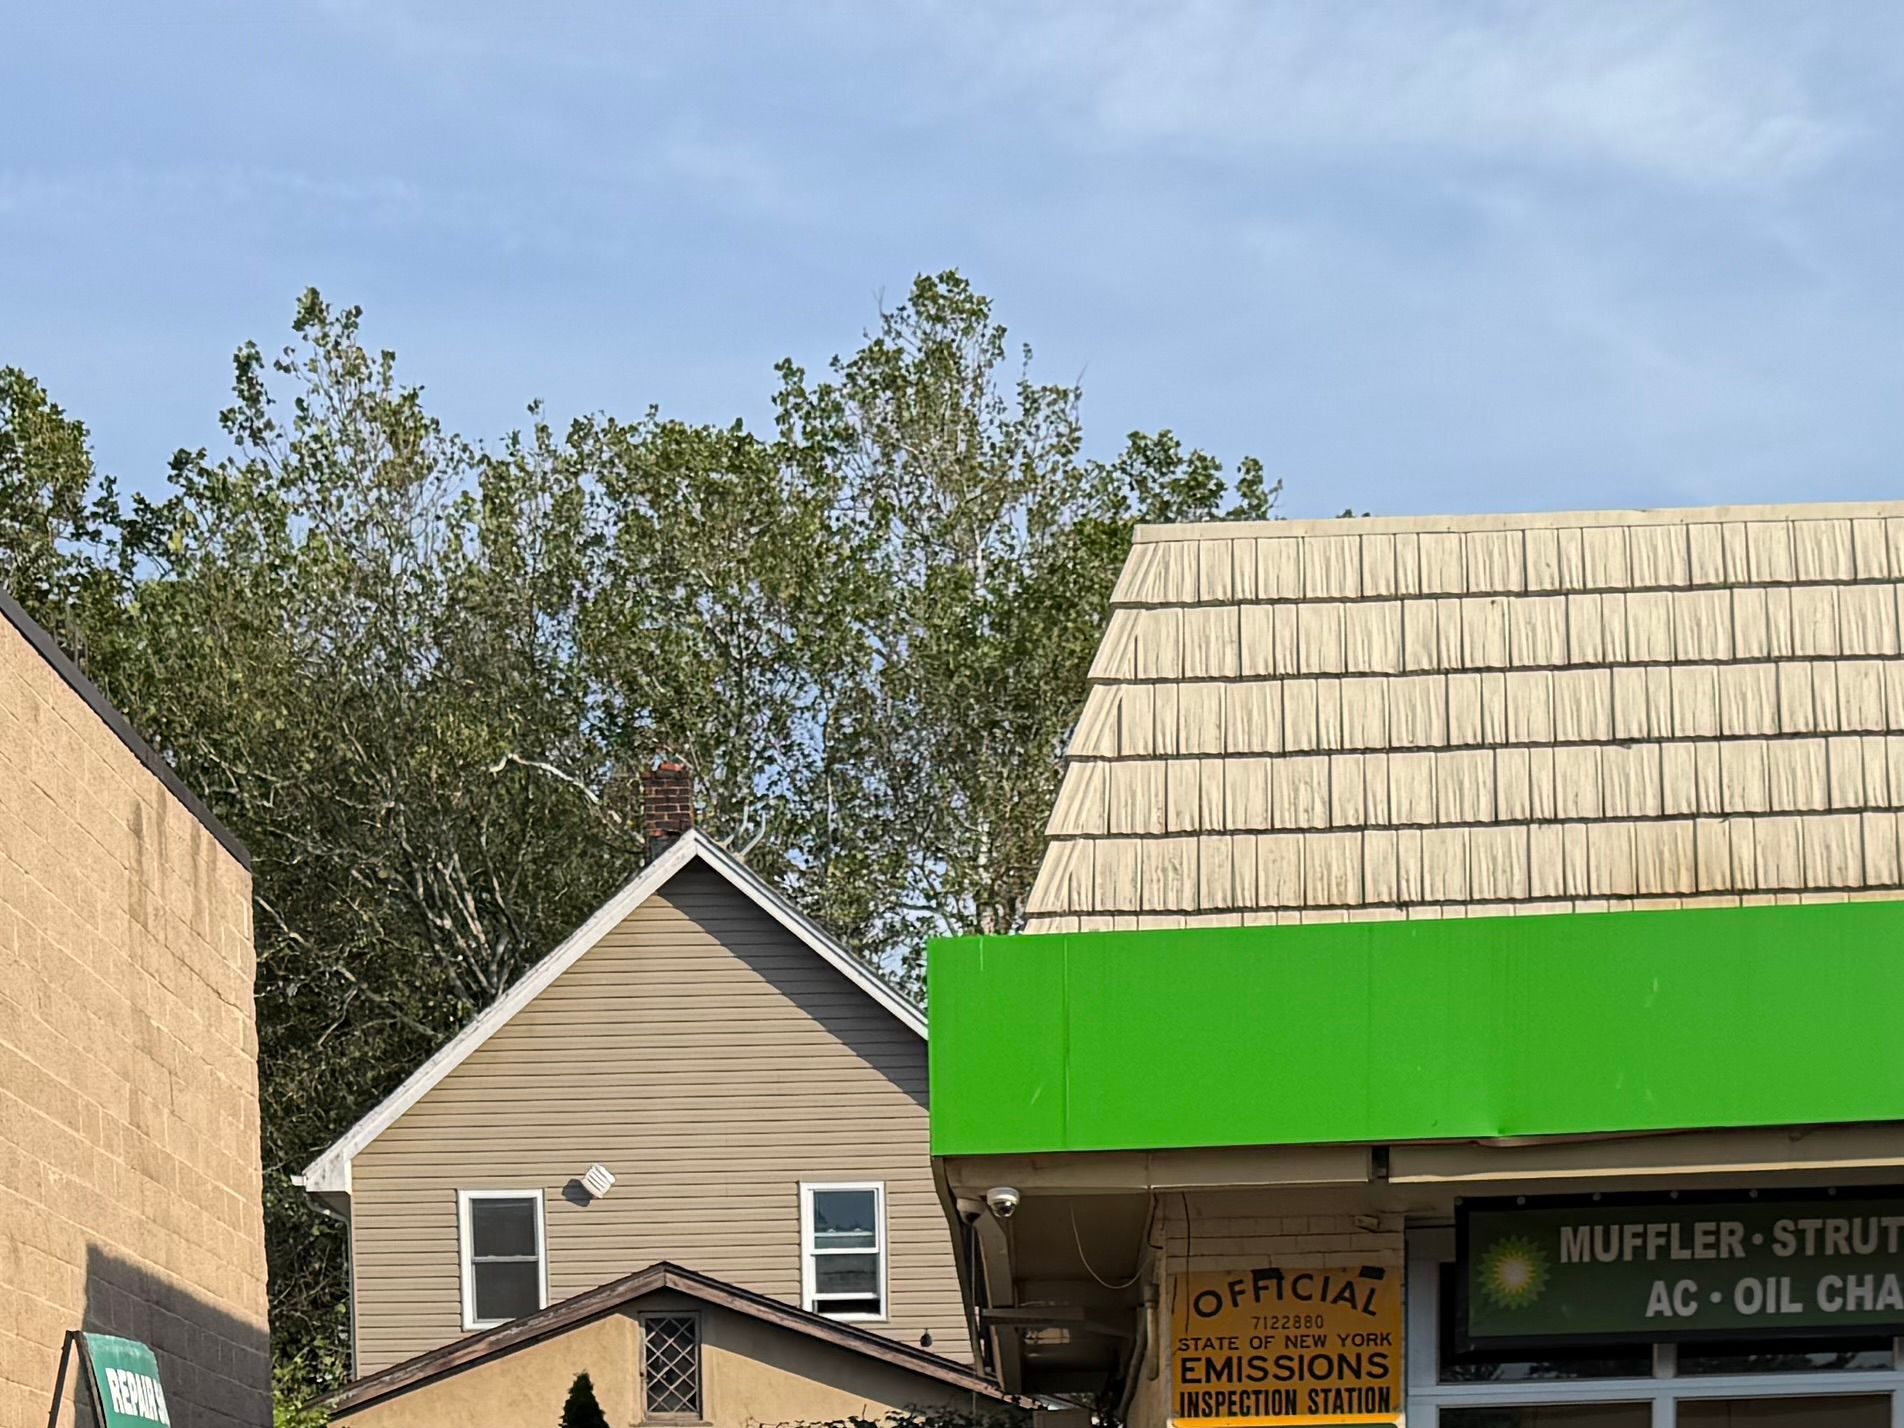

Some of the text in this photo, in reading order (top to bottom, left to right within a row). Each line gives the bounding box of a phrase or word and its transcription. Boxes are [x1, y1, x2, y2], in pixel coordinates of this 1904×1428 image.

[1559, 1222, 1746, 1263] MUFFLER
[1193, 1273, 1377, 1318] OFFICIAL
[1646, 1279, 1698, 1318] AC
[1733, 1276, 1803, 1316] OIL
[1252, 1315, 1324, 1330] 7122880
[1178, 1332, 1392, 1351] STATE OF NEW YORK
[1181, 1352, 1389, 1384] EMISSIONS
[1180, 1387, 1391, 1418] INSPECTION STATION
